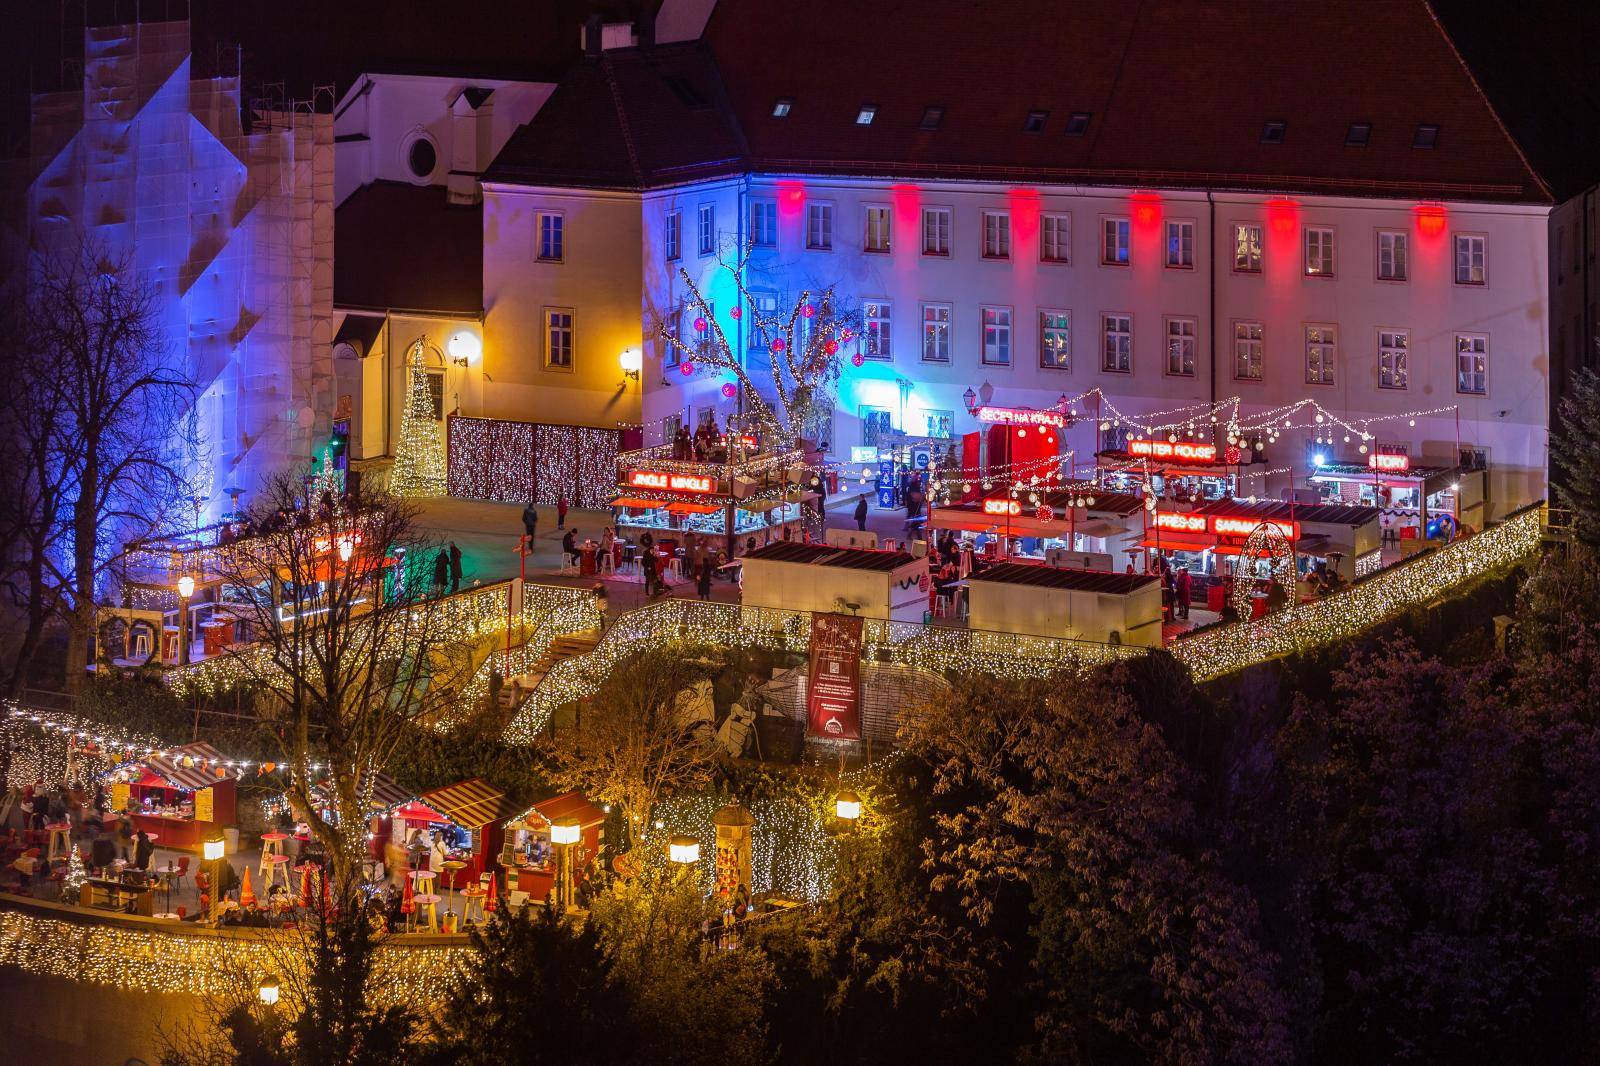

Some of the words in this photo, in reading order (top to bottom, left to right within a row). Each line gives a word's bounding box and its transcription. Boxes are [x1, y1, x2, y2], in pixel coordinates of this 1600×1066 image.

[1132, 442, 1172, 456] WINTER
[1174, 444, 1212, 459] HOUSE
[633, 473, 667, 488] JINGLE
[671, 477, 710, 492] MINGLE
